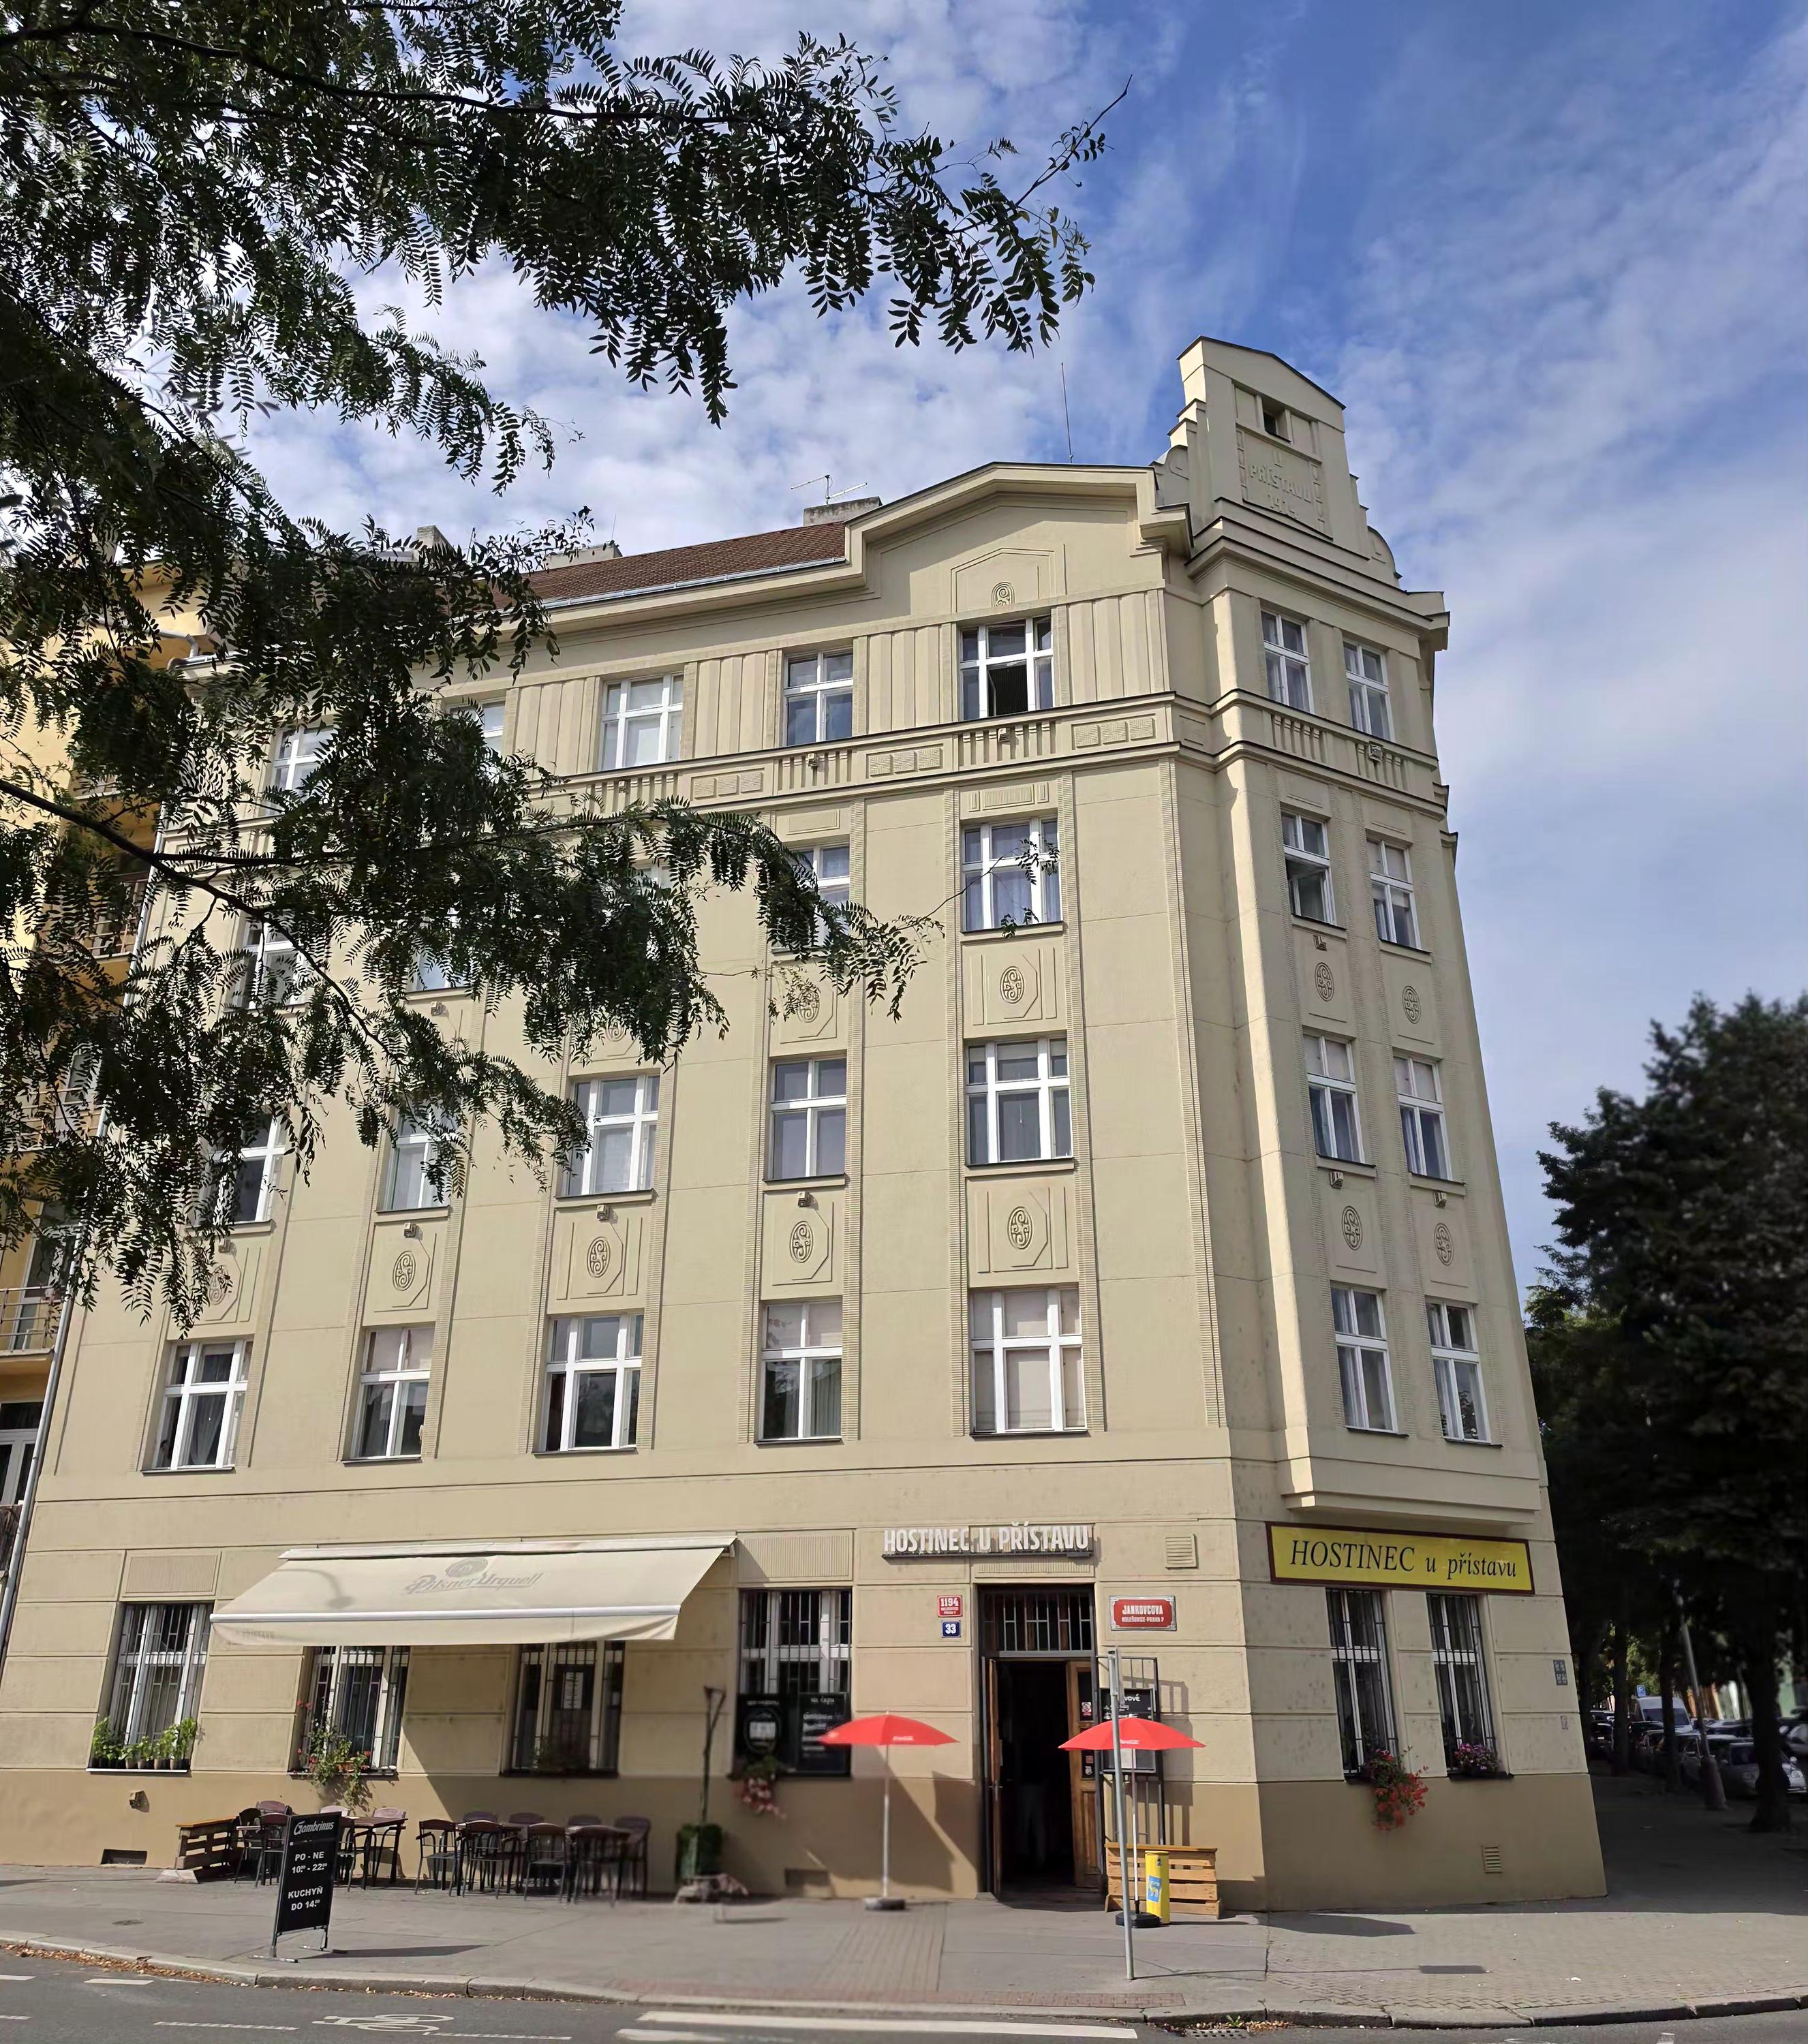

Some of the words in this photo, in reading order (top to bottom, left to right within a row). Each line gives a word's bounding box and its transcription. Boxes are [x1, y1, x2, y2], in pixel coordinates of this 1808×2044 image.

[883, 1528, 969, 1552] HOSTINEC
[979, 1527, 991, 1551] U
[998, 1521, 1089, 1551] PŘÍSTAVU
[1290, 1540, 1415, 1571] HOSTINEC
[1425, 1557, 1436, 1573] u
[1447, 1552, 1516, 1579] přístavu
[404, 1575, 476, 1594] Pilsner
[476, 1572, 544, 1590] Urquell
[940, 1597, 959, 1607] 1194
[1122, 1605, 1163, 1615] JANKOVCOVA
[945, 1624, 957, 1634] 33
[294, 1821, 335, 1835] Gambrinus
[294, 1853, 306, 1861] PO
[288, 1886, 323, 1899] KUCHYŇ
[291, 1902, 303, 1910] DO
